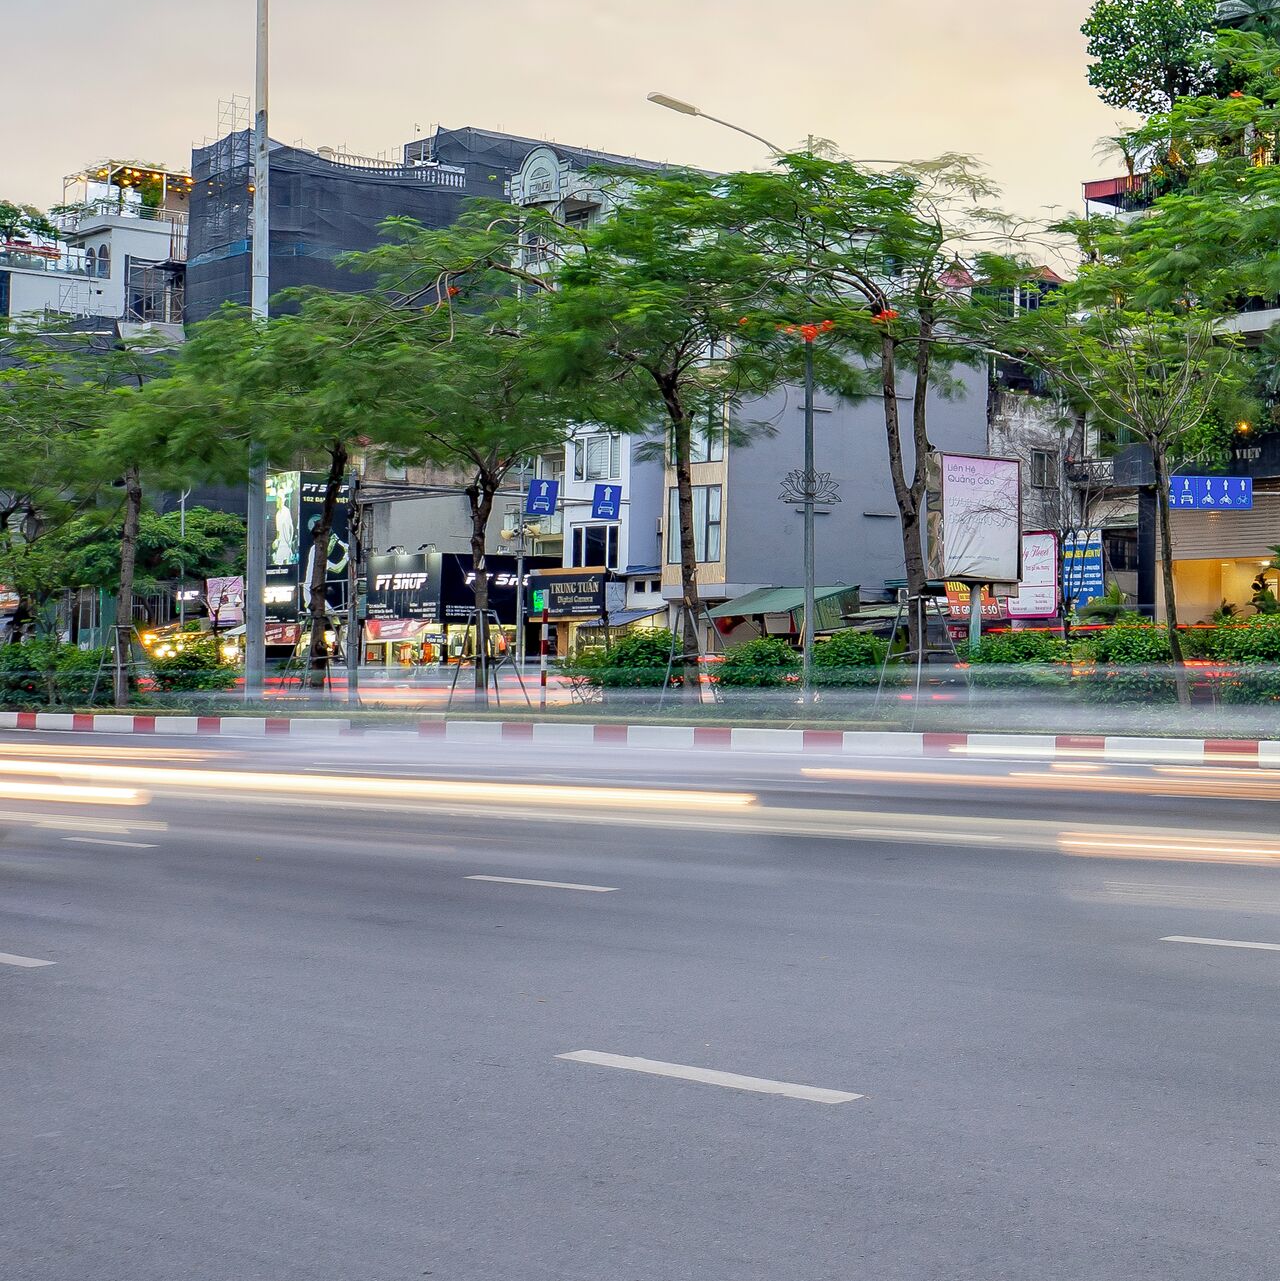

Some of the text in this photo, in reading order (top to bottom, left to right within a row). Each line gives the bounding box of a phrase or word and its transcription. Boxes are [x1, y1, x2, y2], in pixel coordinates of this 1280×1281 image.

[1236, 444, 1262, 463] VIỆT
[947, 463, 976, 474] Liên Hệ
[947, 474, 995, 486] Quảng Cáo
[319, 484, 350, 494] SP
[375, 574, 392, 591] PT
[393, 572, 428, 590] SHOP
[550, 576, 600, 595] TRUNG TUẤN
